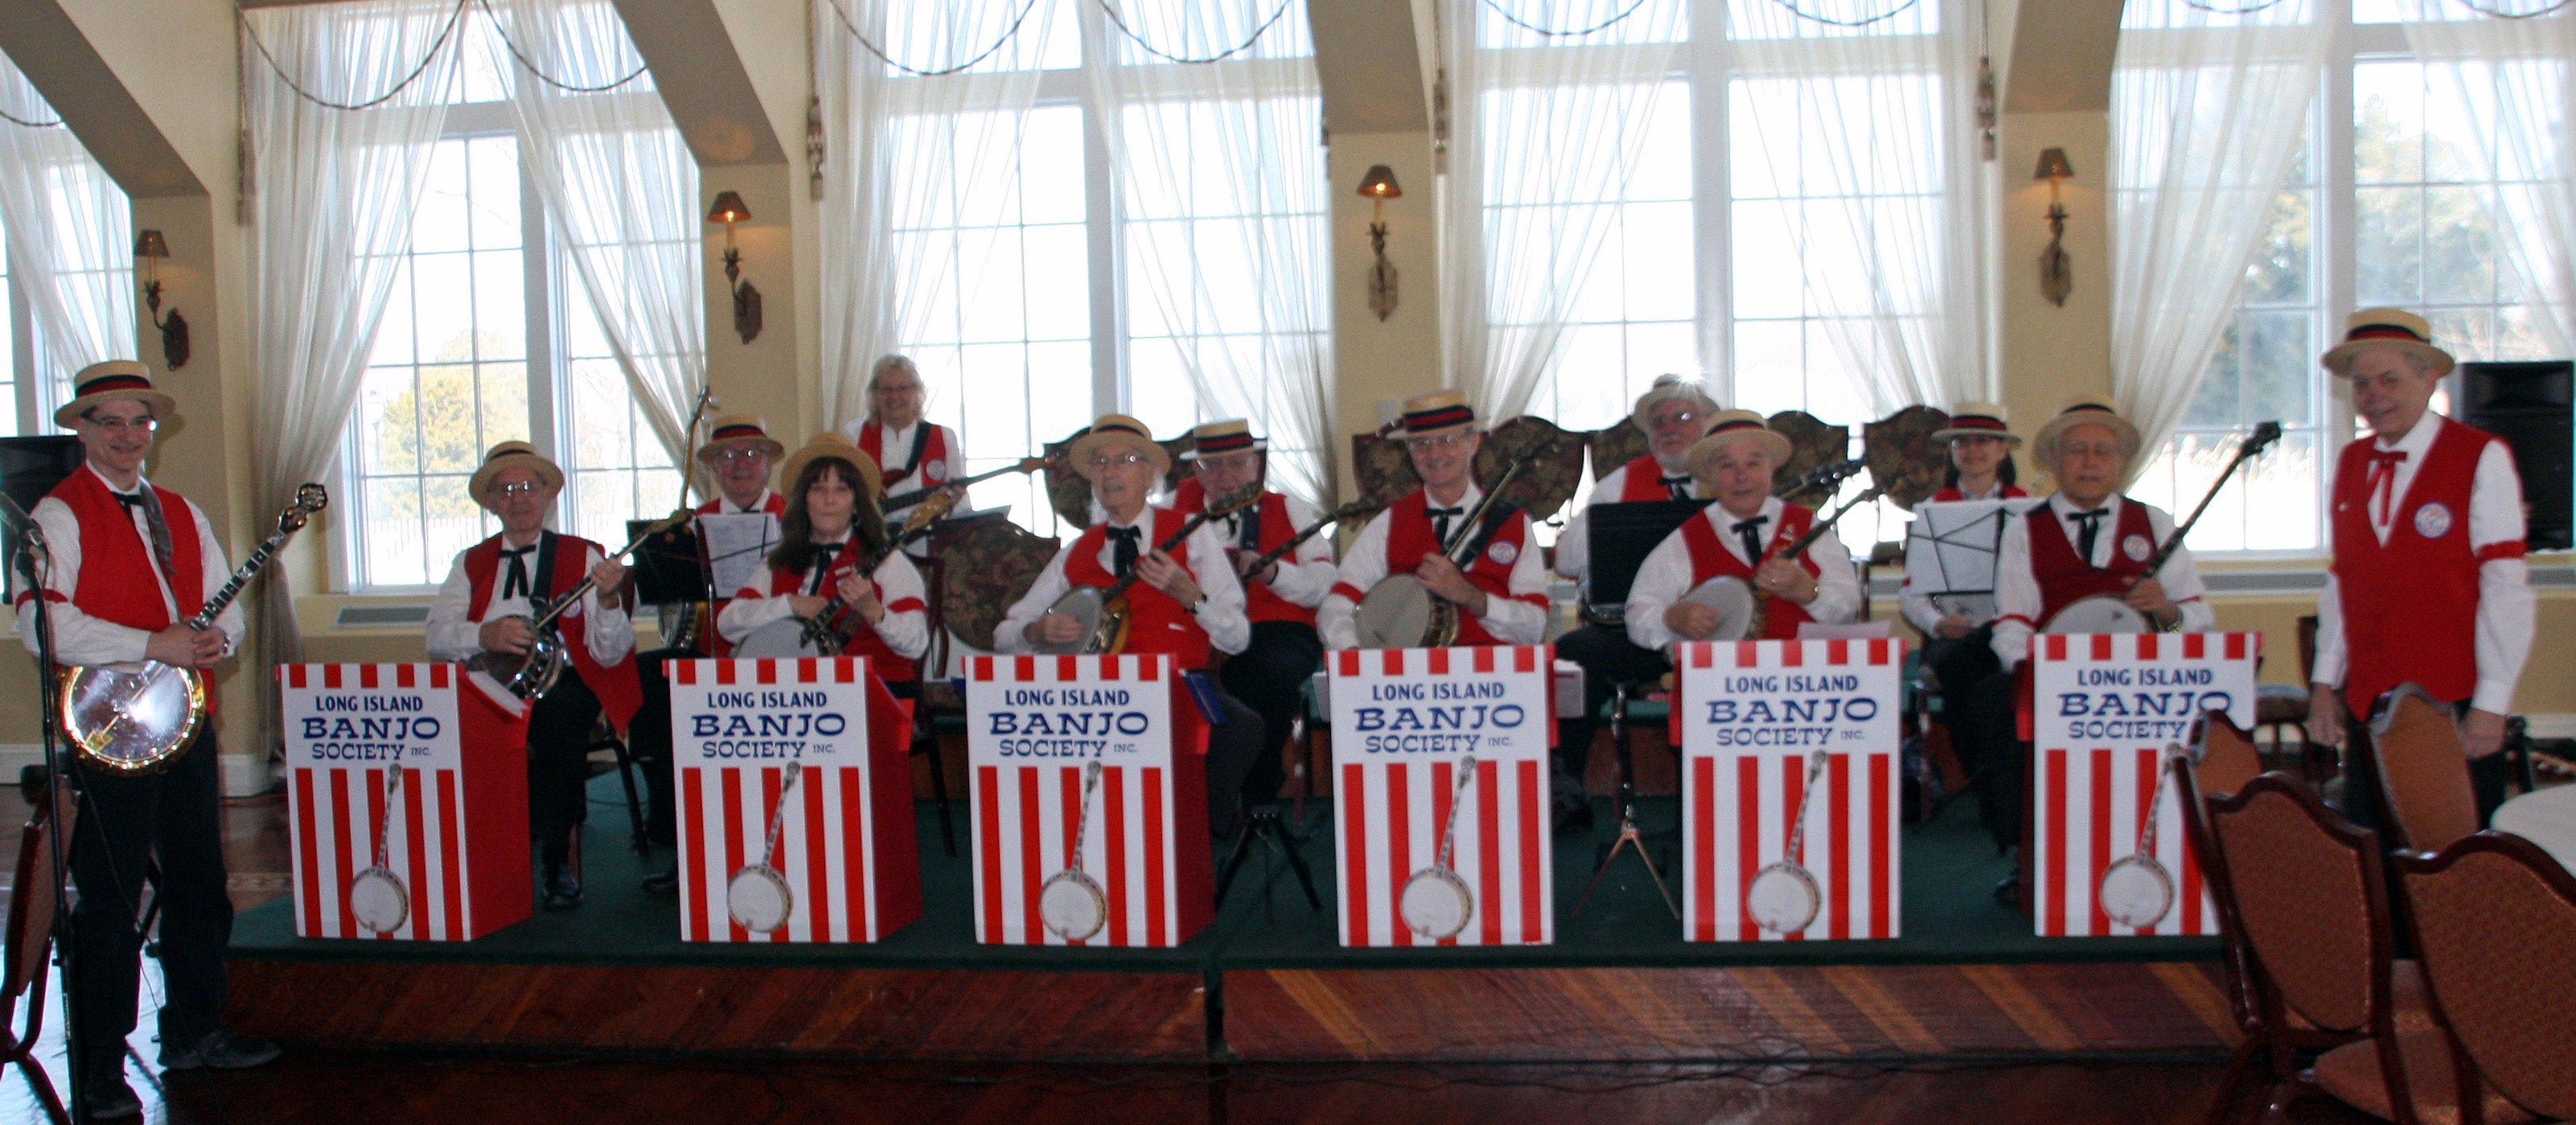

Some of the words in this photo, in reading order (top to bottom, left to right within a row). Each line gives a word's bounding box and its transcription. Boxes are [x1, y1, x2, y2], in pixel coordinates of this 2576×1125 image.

[1724, 675, 1778, 693] LONG
[1785, 675, 1859, 692] ISLAND
[2077, 669, 2131, 687] LONG
[2138, 668, 2213, 686] ISLAND
[707, 692, 755, 708] LONG
[761, 691, 828, 708] ISLAND
[1005, 690, 1054, 706] LONG
[1061, 689, 1130, 705] ISLAND
[1372, 684, 1425, 701] LONG
[1432, 682, 1506, 699] ISLAND
[315, 696, 358, 713] LONG
[363, 696, 423, 712] ISLAND
[1706, 696, 1878, 725] BANJO
[2058, 691, 2233, 717] BANJO
[691, 712, 846, 737] BANJO
[988, 711, 1148, 737] BANJO
[1354, 704, 1526, 731] BANJO
[301, 716, 441, 741] BANJO
[1716, 727, 1834, 746] SOCIETY
[2068, 720, 2188, 740] SOCIETY
[311, 741, 405, 761] SOCIETY
[702, 740, 806, 759] SOCIETY
[999, 738, 1107, 758] SOCIETY
[1365, 733, 1481, 753] SOCIETY
